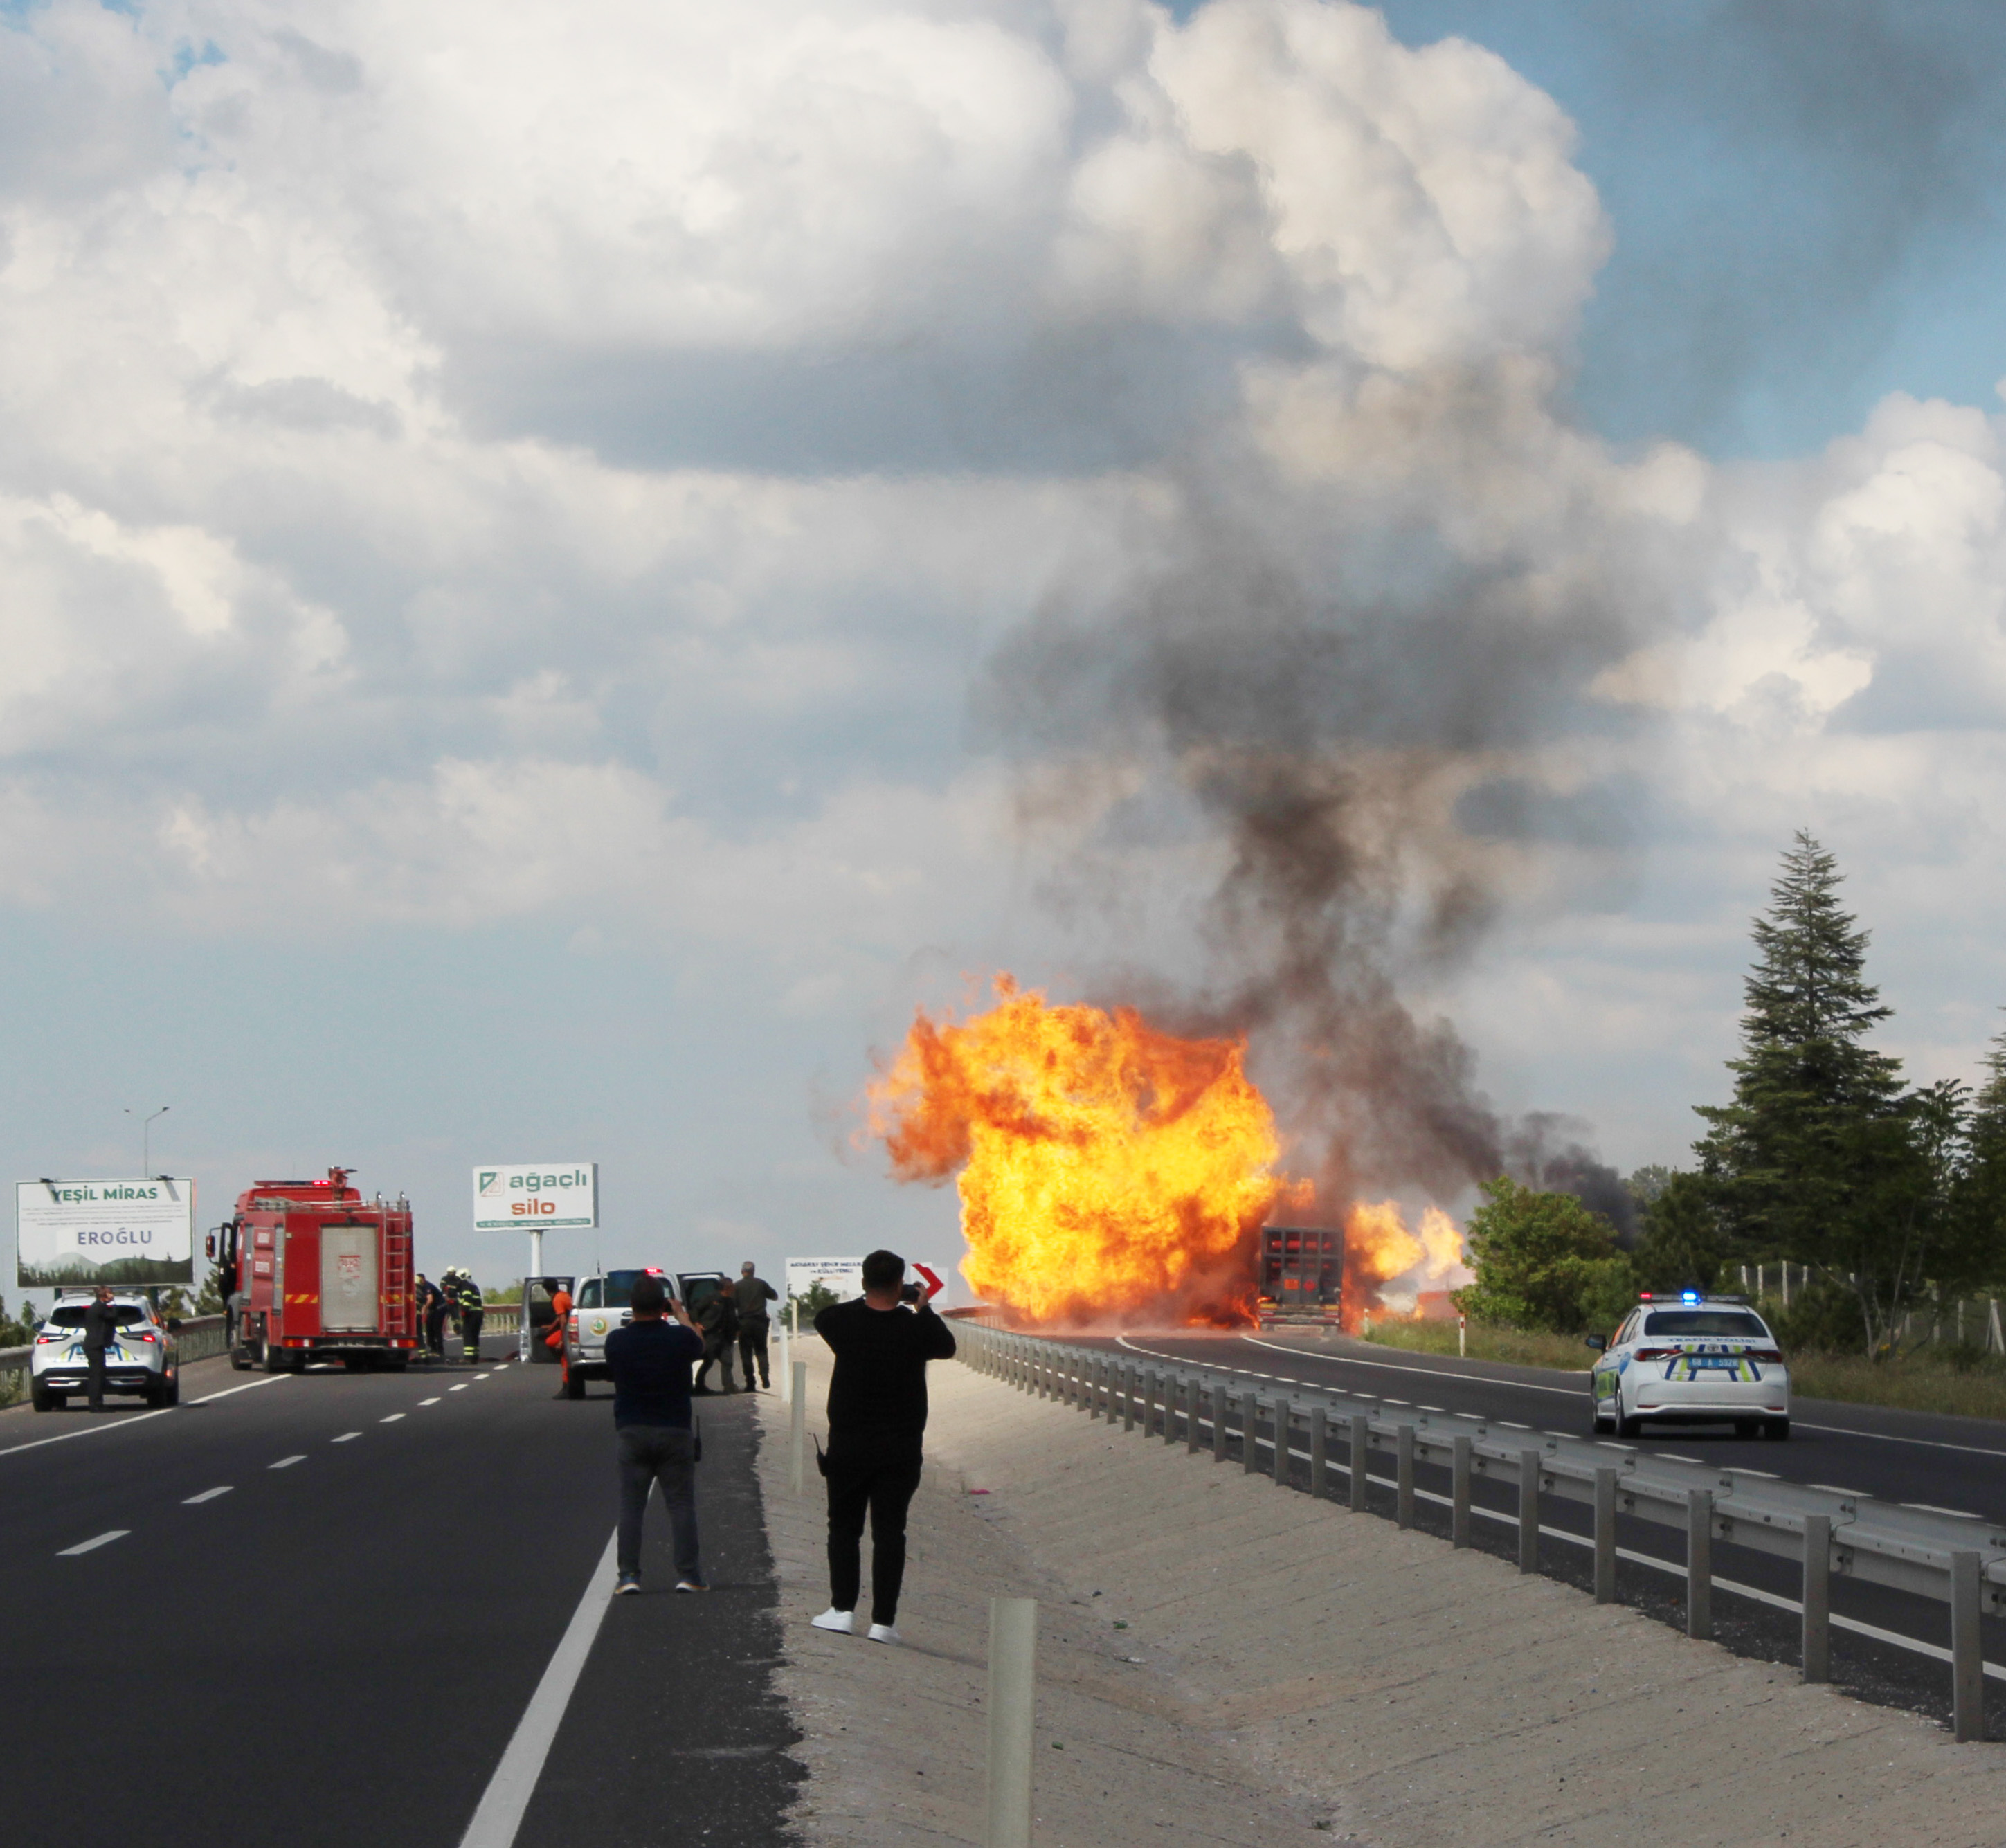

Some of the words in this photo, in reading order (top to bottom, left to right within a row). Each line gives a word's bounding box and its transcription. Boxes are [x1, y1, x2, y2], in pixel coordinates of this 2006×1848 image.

[509, 1170, 587, 1192] ağaçlı
[51, 1185, 98, 1204] YEŞİL
[104, 1184, 158, 1201] MİRAS
[511, 1198, 556, 1215] silo
[78, 1228, 152, 1245] EROĞLU
